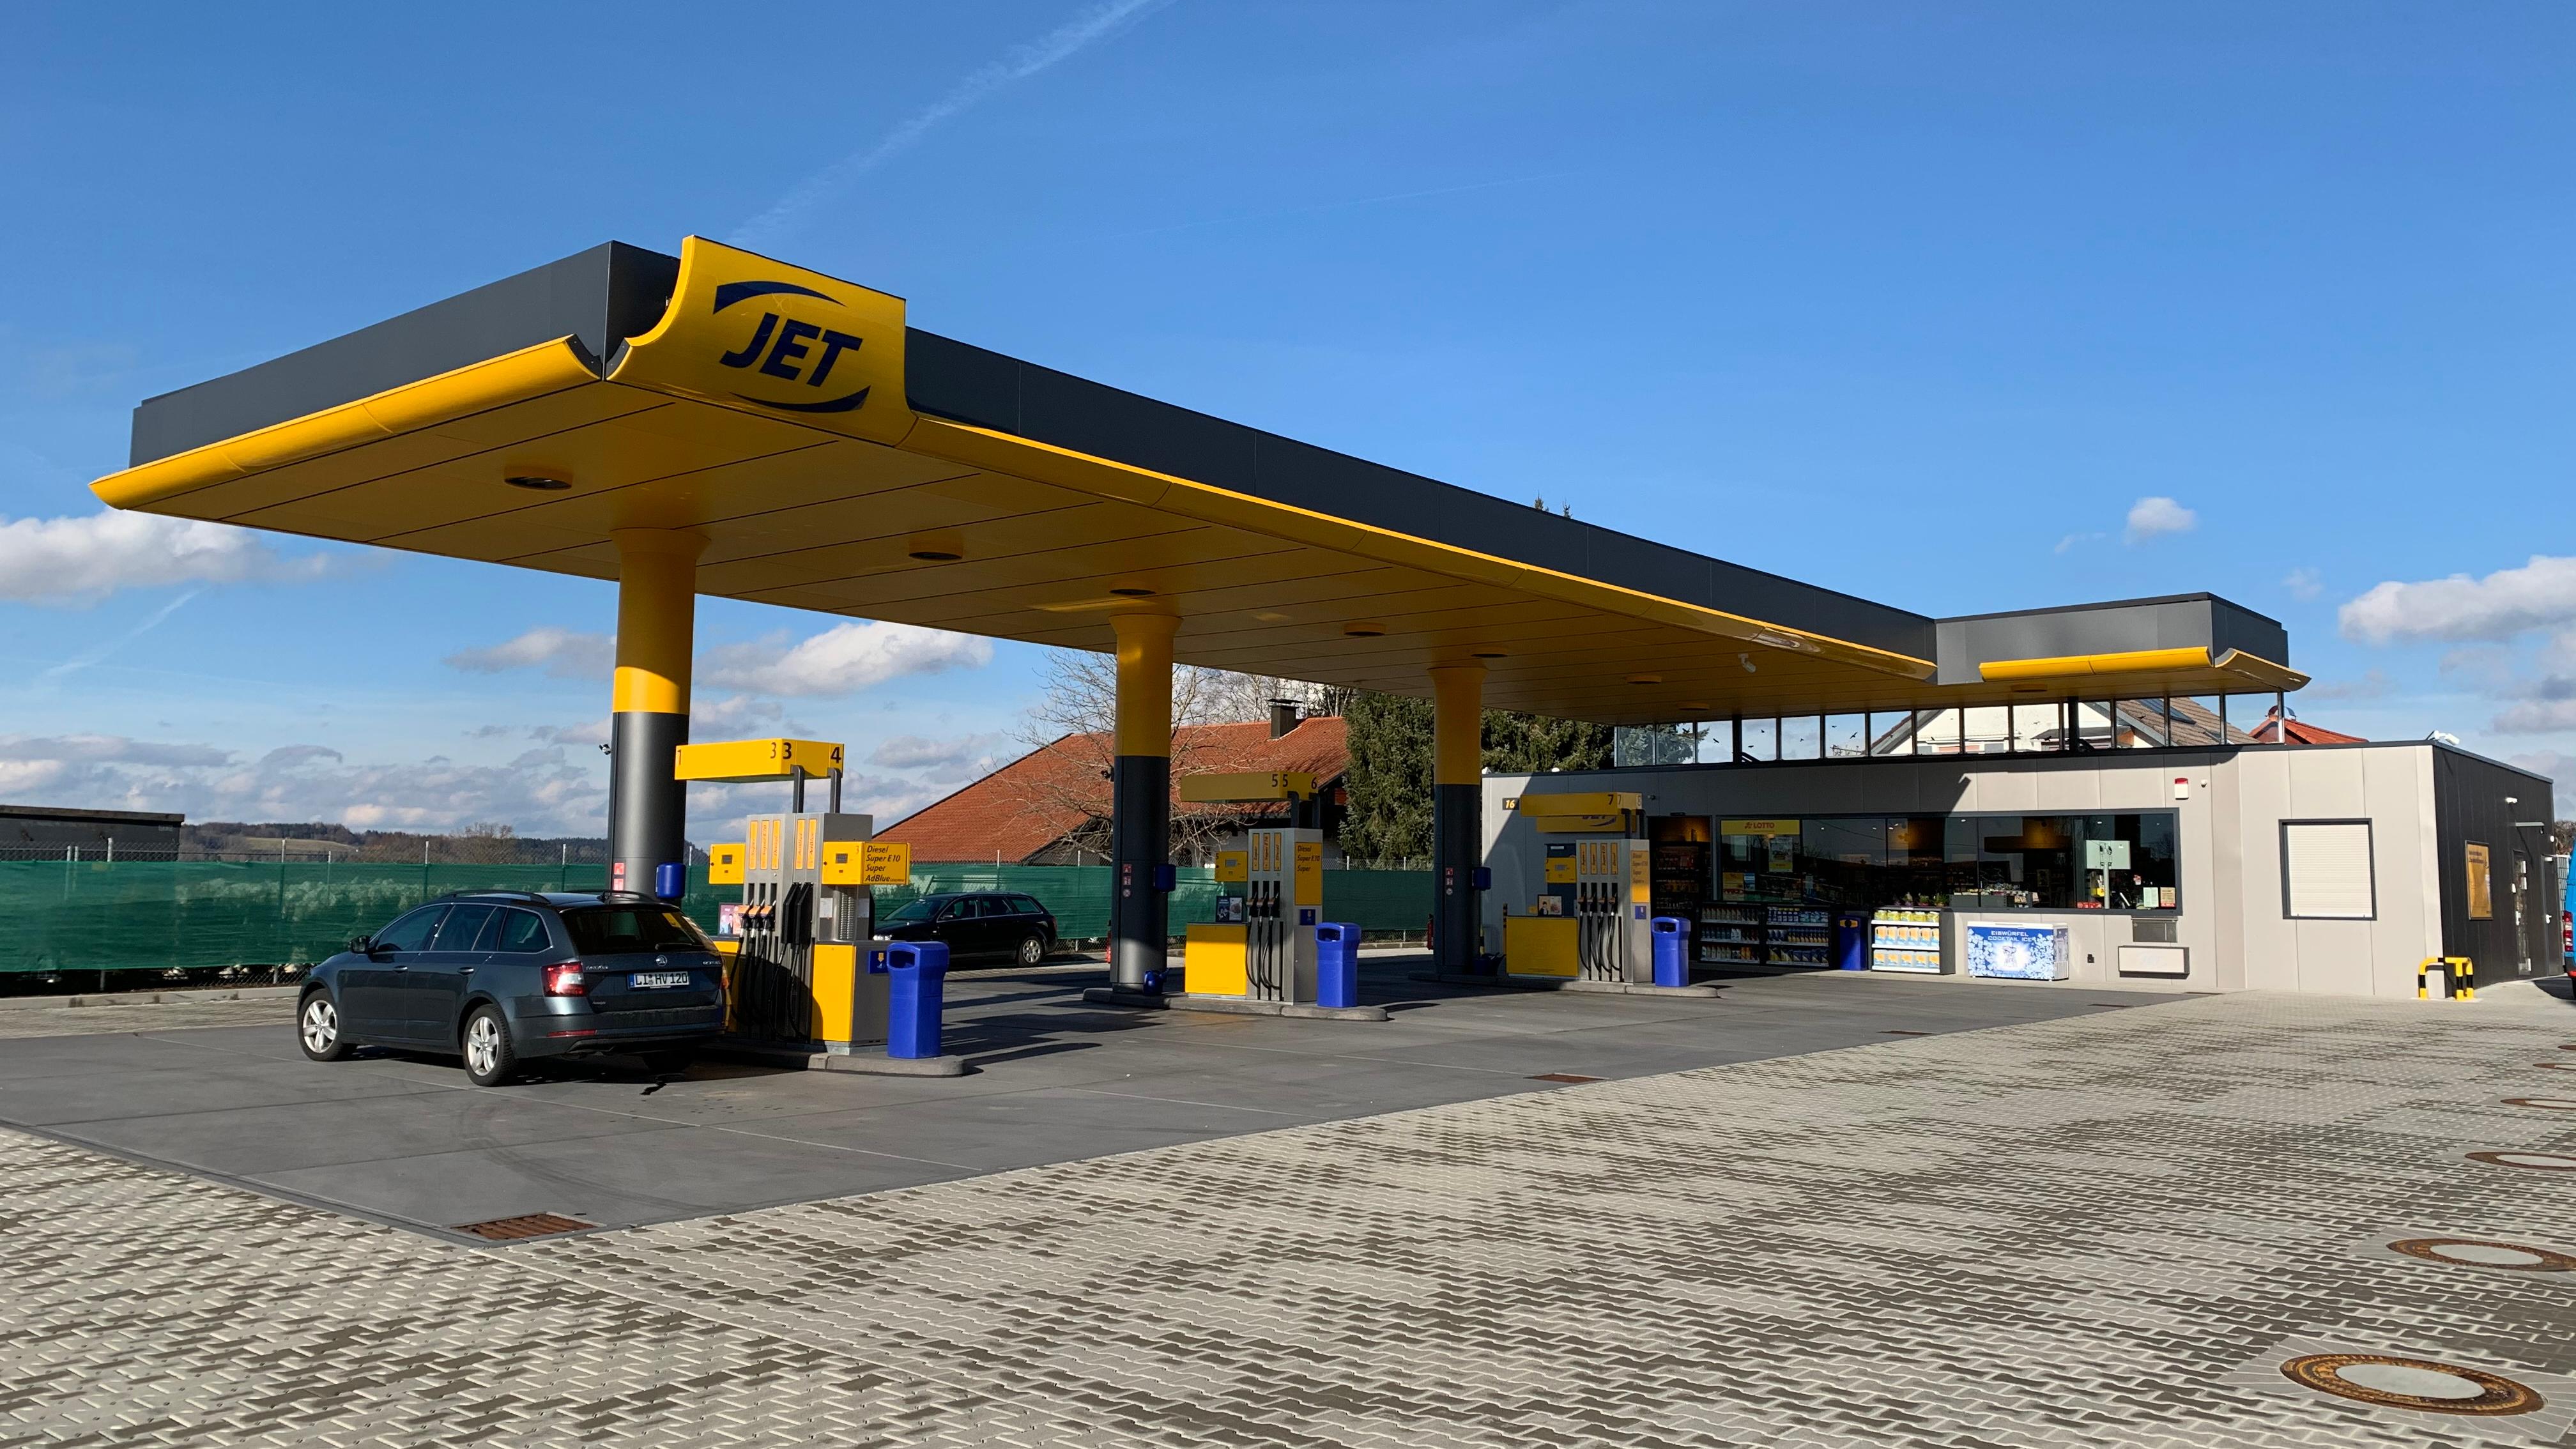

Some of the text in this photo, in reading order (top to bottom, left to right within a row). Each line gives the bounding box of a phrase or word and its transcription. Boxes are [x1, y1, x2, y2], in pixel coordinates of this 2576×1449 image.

[719, 312, 863, 387] JET
[677, 749, 682, 765] 1
[770, 742, 777, 759] 3
[783, 742, 792, 759] 3
[831, 746, 841, 763] 4
[1272, 774, 1278, 787] 5
[1282, 774, 1288, 787] 5
[1311, 777, 1317, 789] 6
[1505, 799, 1515, 809] 16
[1607, 794, 1614, 805] 7
[1618, 795, 1621, 805] 7
[866, 854, 886, 863] Super
[866, 864, 886, 873] Super
[1297, 865, 1310, 873] Super
[636, 972, 688, 985] LI HV 120
